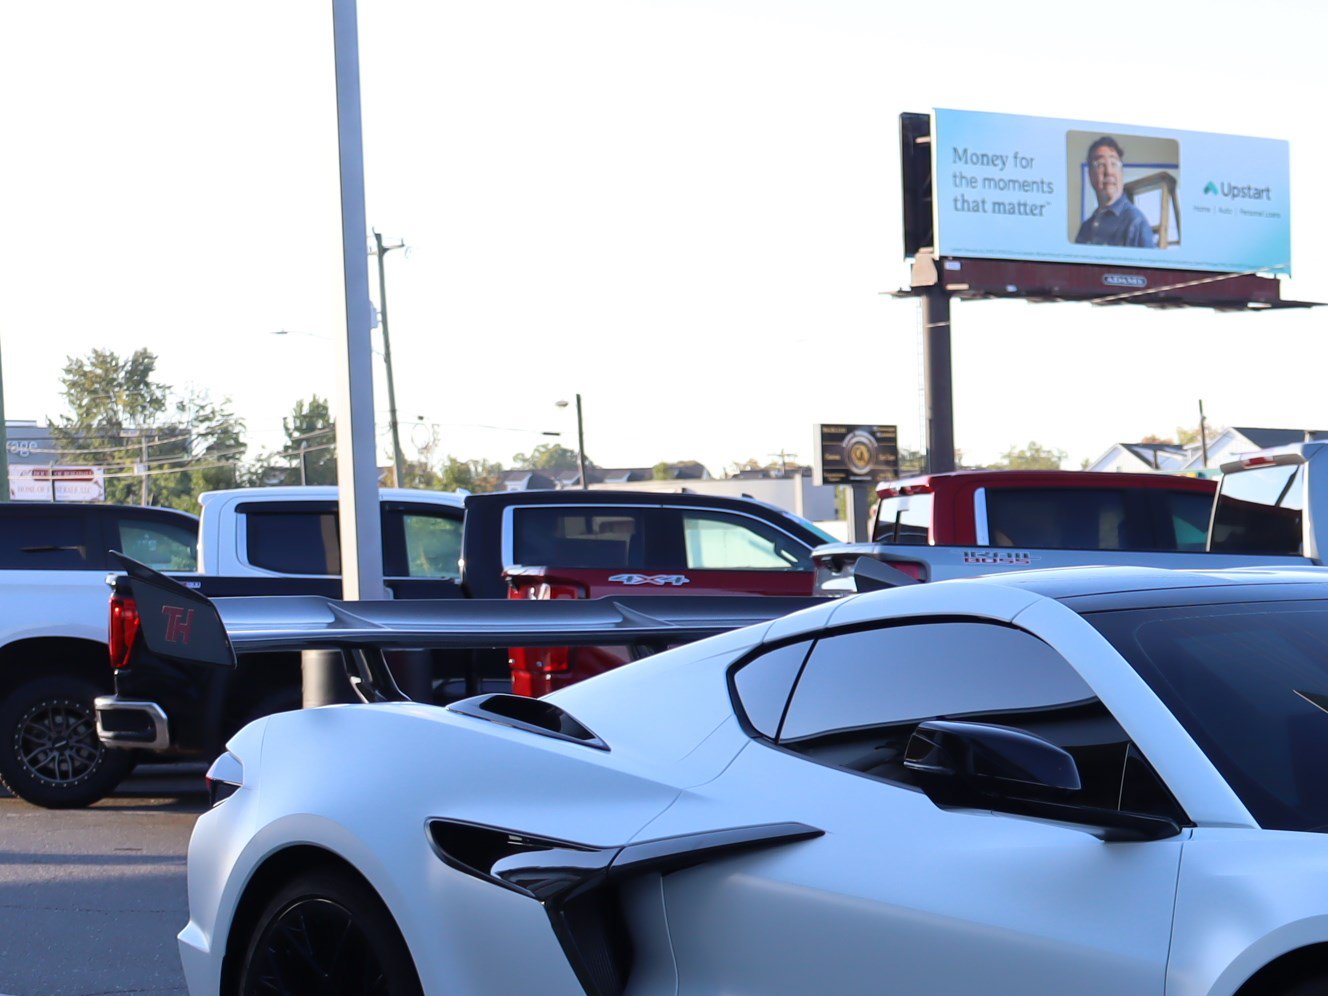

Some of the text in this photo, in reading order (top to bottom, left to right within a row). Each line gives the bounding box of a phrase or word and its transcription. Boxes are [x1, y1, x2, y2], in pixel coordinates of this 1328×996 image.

[952, 146, 1036, 172] Money for
[952, 172, 1055, 194] the moments
[1220, 182, 1272, 201] Upstart
[952, 193, 988, 213] that
